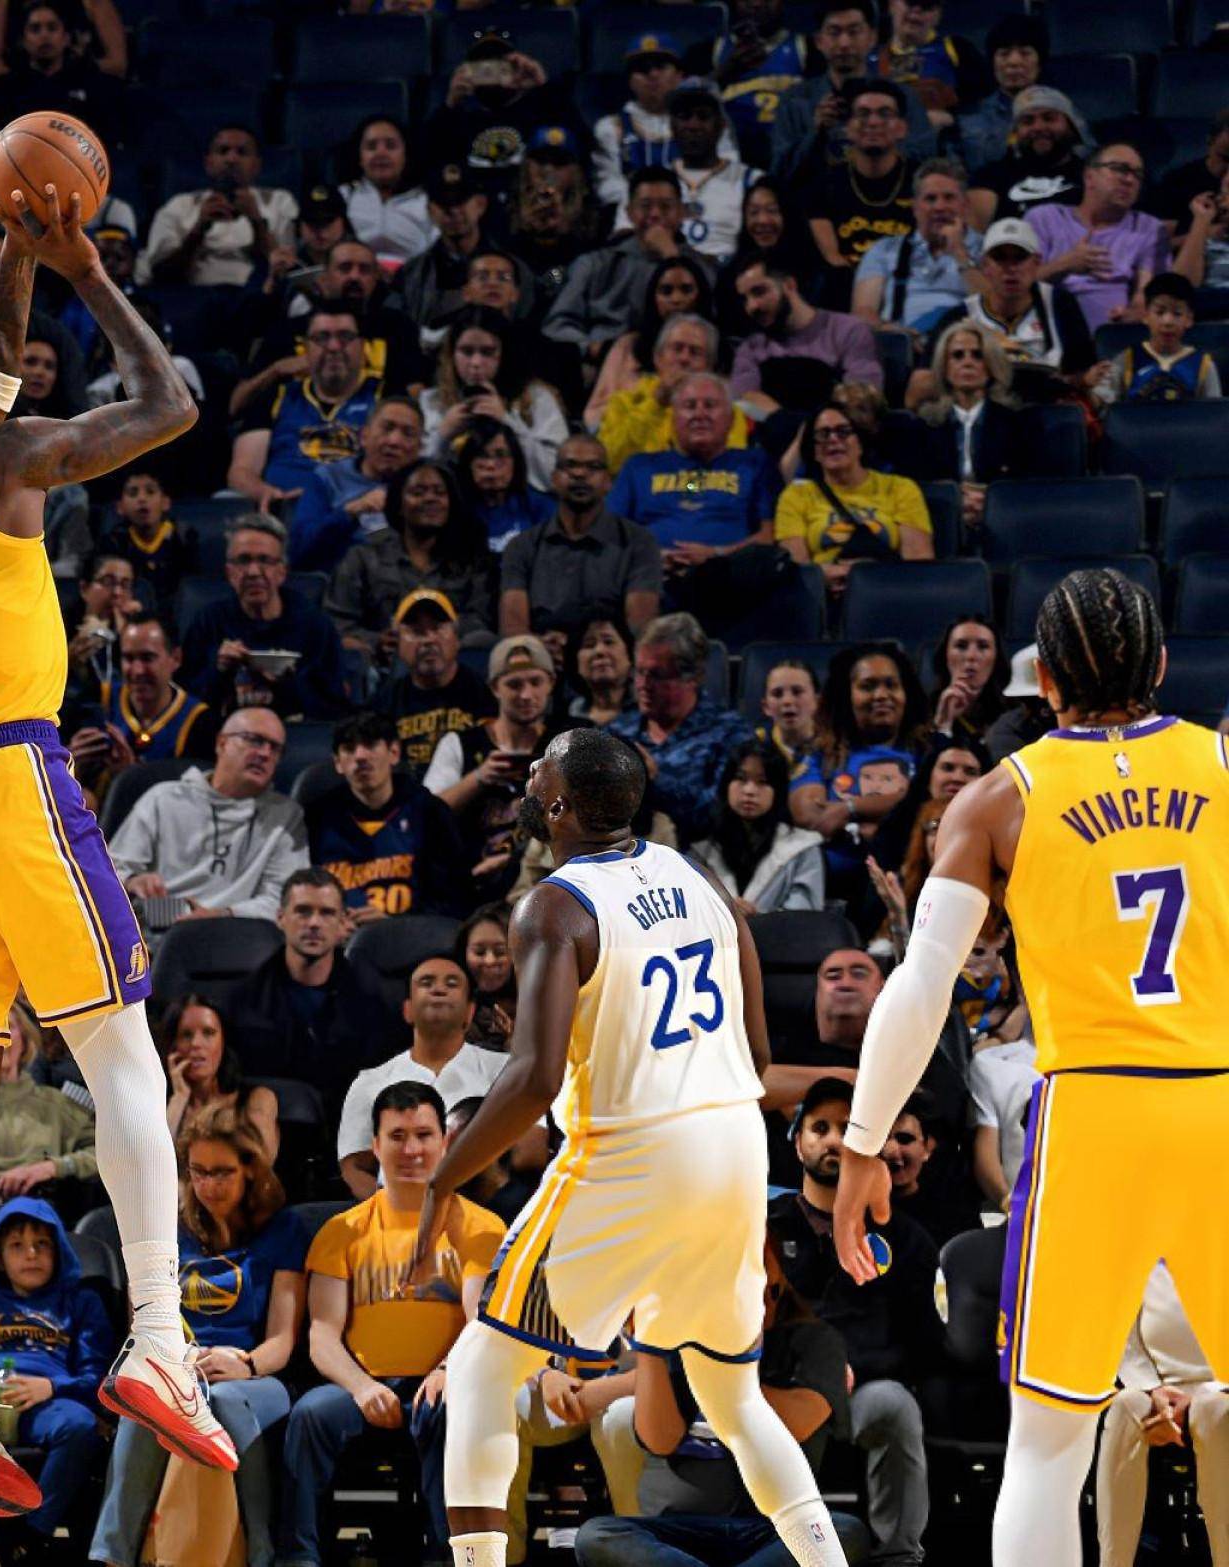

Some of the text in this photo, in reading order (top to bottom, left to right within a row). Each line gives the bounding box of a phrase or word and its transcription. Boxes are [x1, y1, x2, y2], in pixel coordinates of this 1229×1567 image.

[47, 119, 107, 179] Wilson
[1059, 786, 1210, 845] VINCENT
[365, 883, 412, 914] 30
[627, 887, 687, 931] GREEN
[1112, 863, 1190, 1006] 7
[641, 938, 724, 1050] 23
